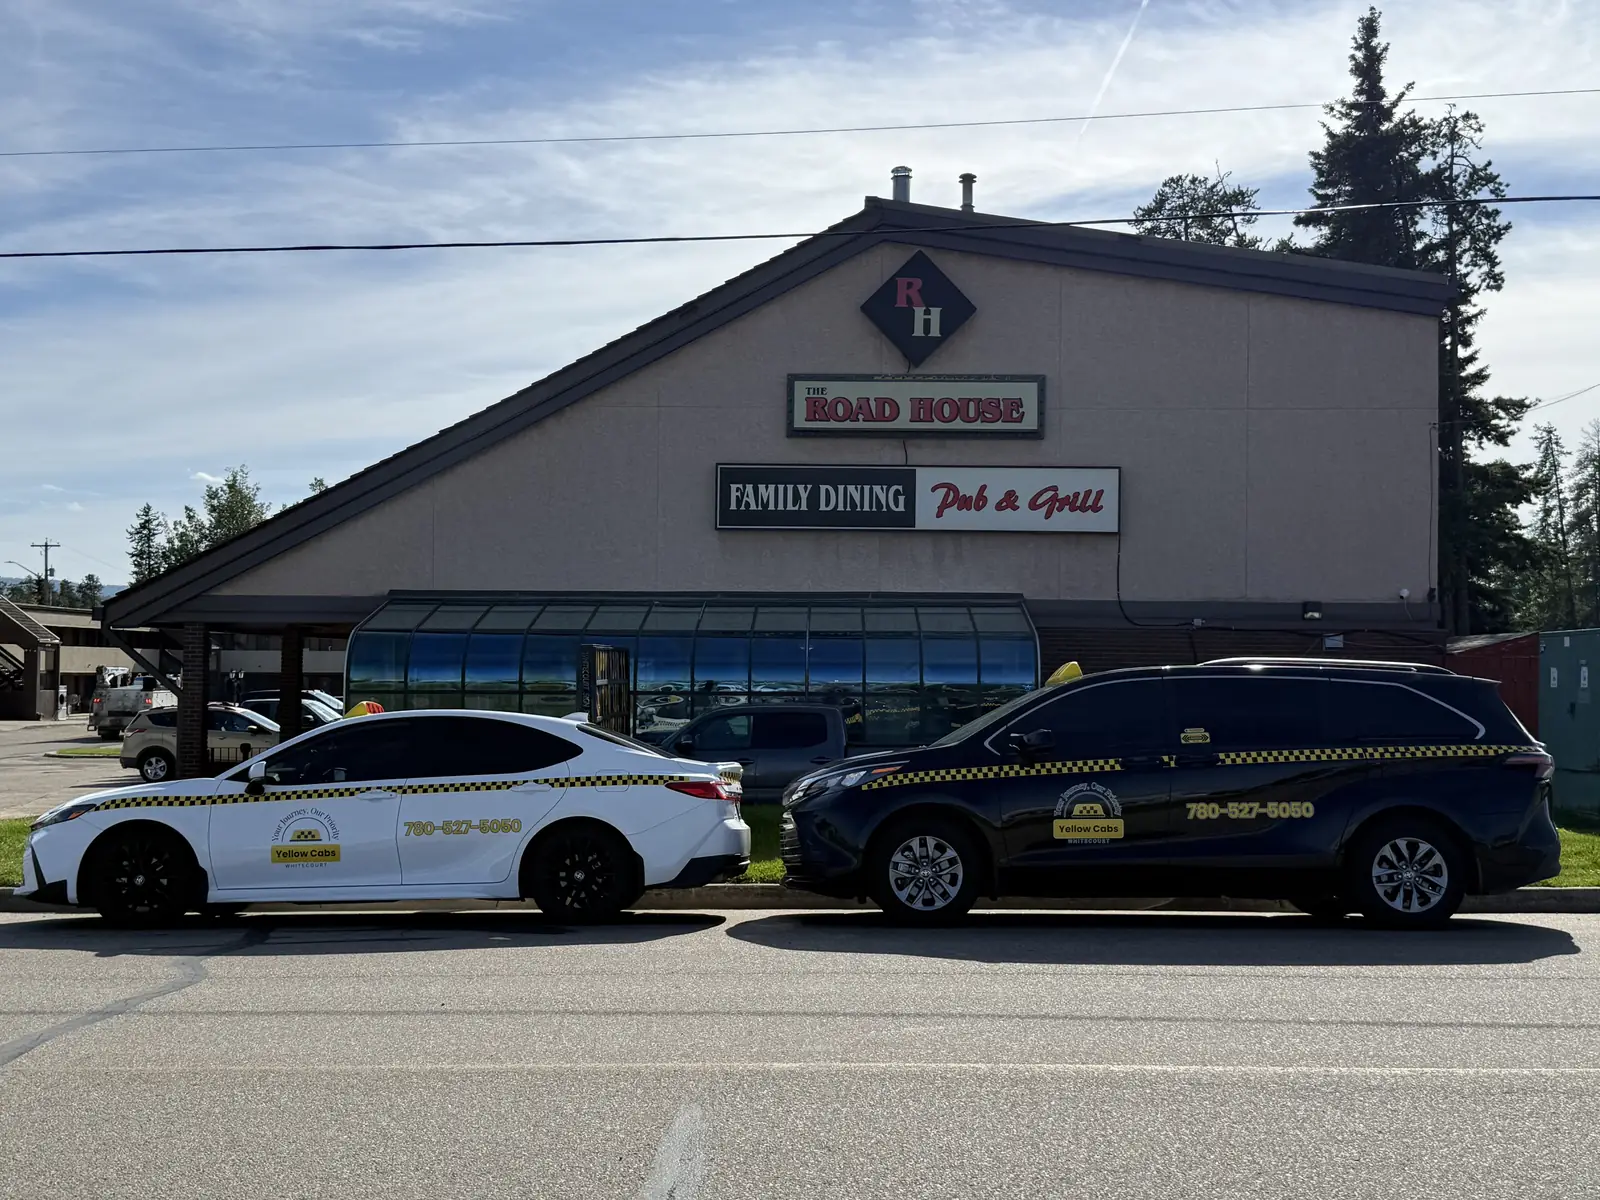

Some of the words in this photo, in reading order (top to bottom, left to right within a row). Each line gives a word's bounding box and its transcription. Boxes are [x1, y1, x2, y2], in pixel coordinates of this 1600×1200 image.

[894, 277, 925, 308] R
[911, 306, 943, 338] H
[805, 386, 828, 396] THE
[804, 396, 900, 422] ROAD
[909, 397, 1025, 423] HOUSE
[729, 483, 813, 511] FAMILY
[818, 484, 906, 512] DINING
[930, 482, 988, 519] Pub
[994, 489, 1020, 512] &
[1027, 484, 1105, 520] Grill
[271, 823, 282, 841] Your
[310, 807, 325, 817] Our
[323, 813, 340, 840] Priority
[1186, 801, 1315, 820] 780-527-5050
[403, 818, 523, 837] 780-527-5050
[1058, 825, 1091, 833] Yellow
[1093, 825, 1119, 833] Cabs
[276, 849, 309, 858] Yellow
[310, 849, 336, 857] Cabs
